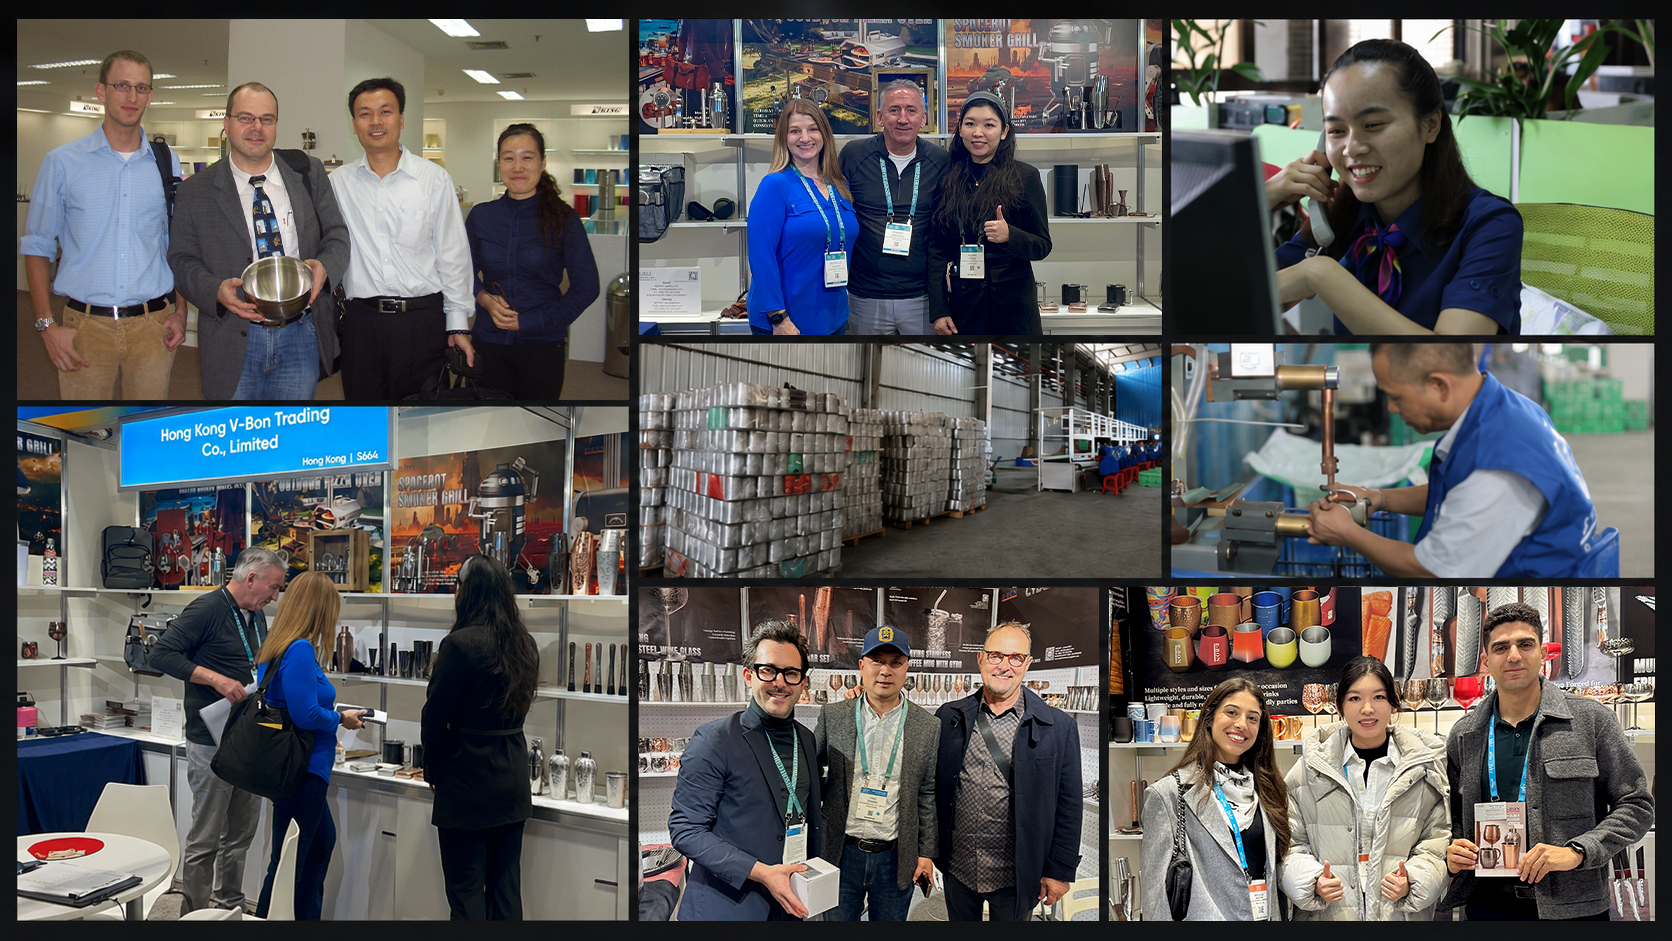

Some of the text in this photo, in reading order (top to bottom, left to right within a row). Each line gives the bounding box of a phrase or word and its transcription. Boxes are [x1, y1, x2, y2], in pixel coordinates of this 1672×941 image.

[954, 32, 1039, 48] SMOKER GRILL
[161, 408, 330, 442] Hong Kong V-Bon Trading
[202, 434, 279, 457] Co., Limited
[302, 456, 324, 467] Hong
[325, 454, 346, 465] Kong
[356, 450, 379, 461] S664
[442, 488, 470, 505] GRILL
[639, 644, 657, 654] STEEL
[680, 646, 702, 657] GLASS
[820, 654, 830, 663] SET
[923, 659, 935, 668] MUG
[1170, 686, 1186, 694] styles
[1184, 701, 1197, 709] fully
[1277, 698, 1298, 706] parties
